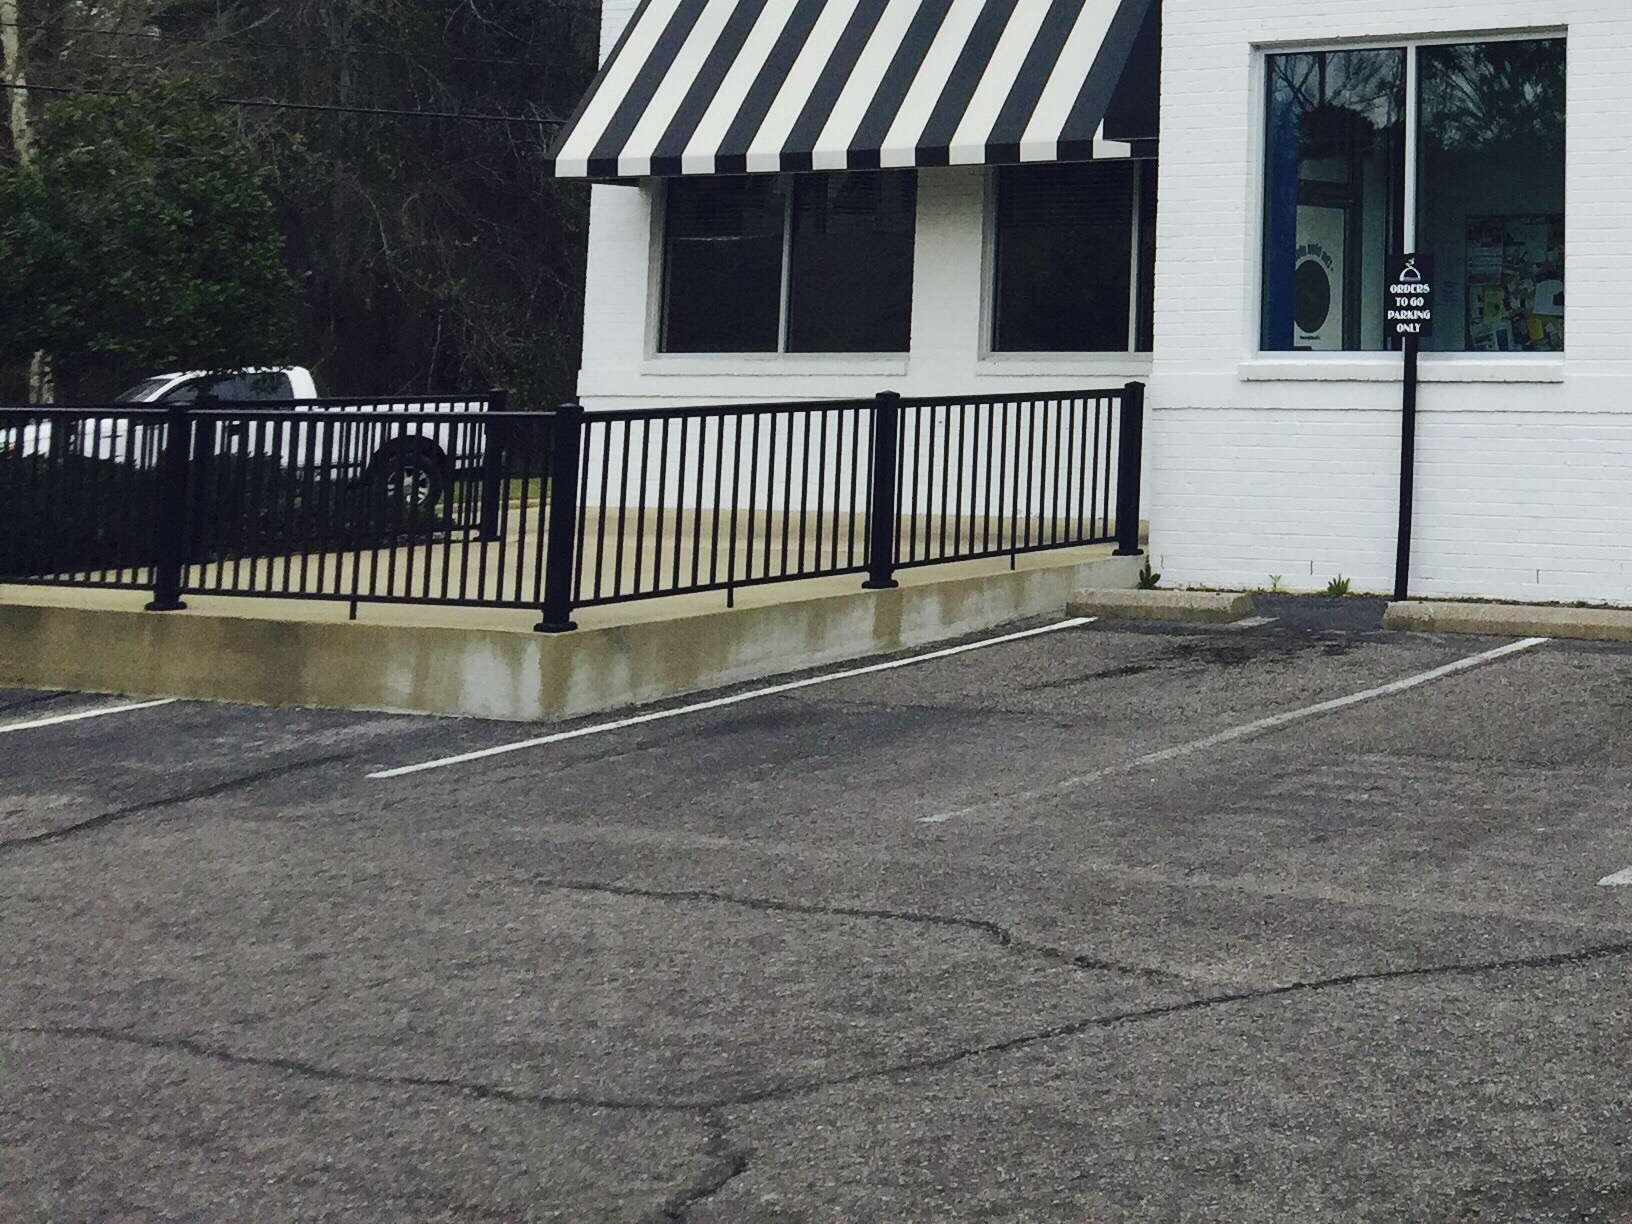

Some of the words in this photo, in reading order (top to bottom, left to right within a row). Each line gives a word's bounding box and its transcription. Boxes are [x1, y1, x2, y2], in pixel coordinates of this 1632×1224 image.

[1389, 283, 1430, 294] ORDERS
[1395, 296, 1408, 307] TO
[1409, 296, 1425, 307] GO
[1387, 309, 1431, 320] PARKING
[1396, 322, 1421, 333] ONLY
